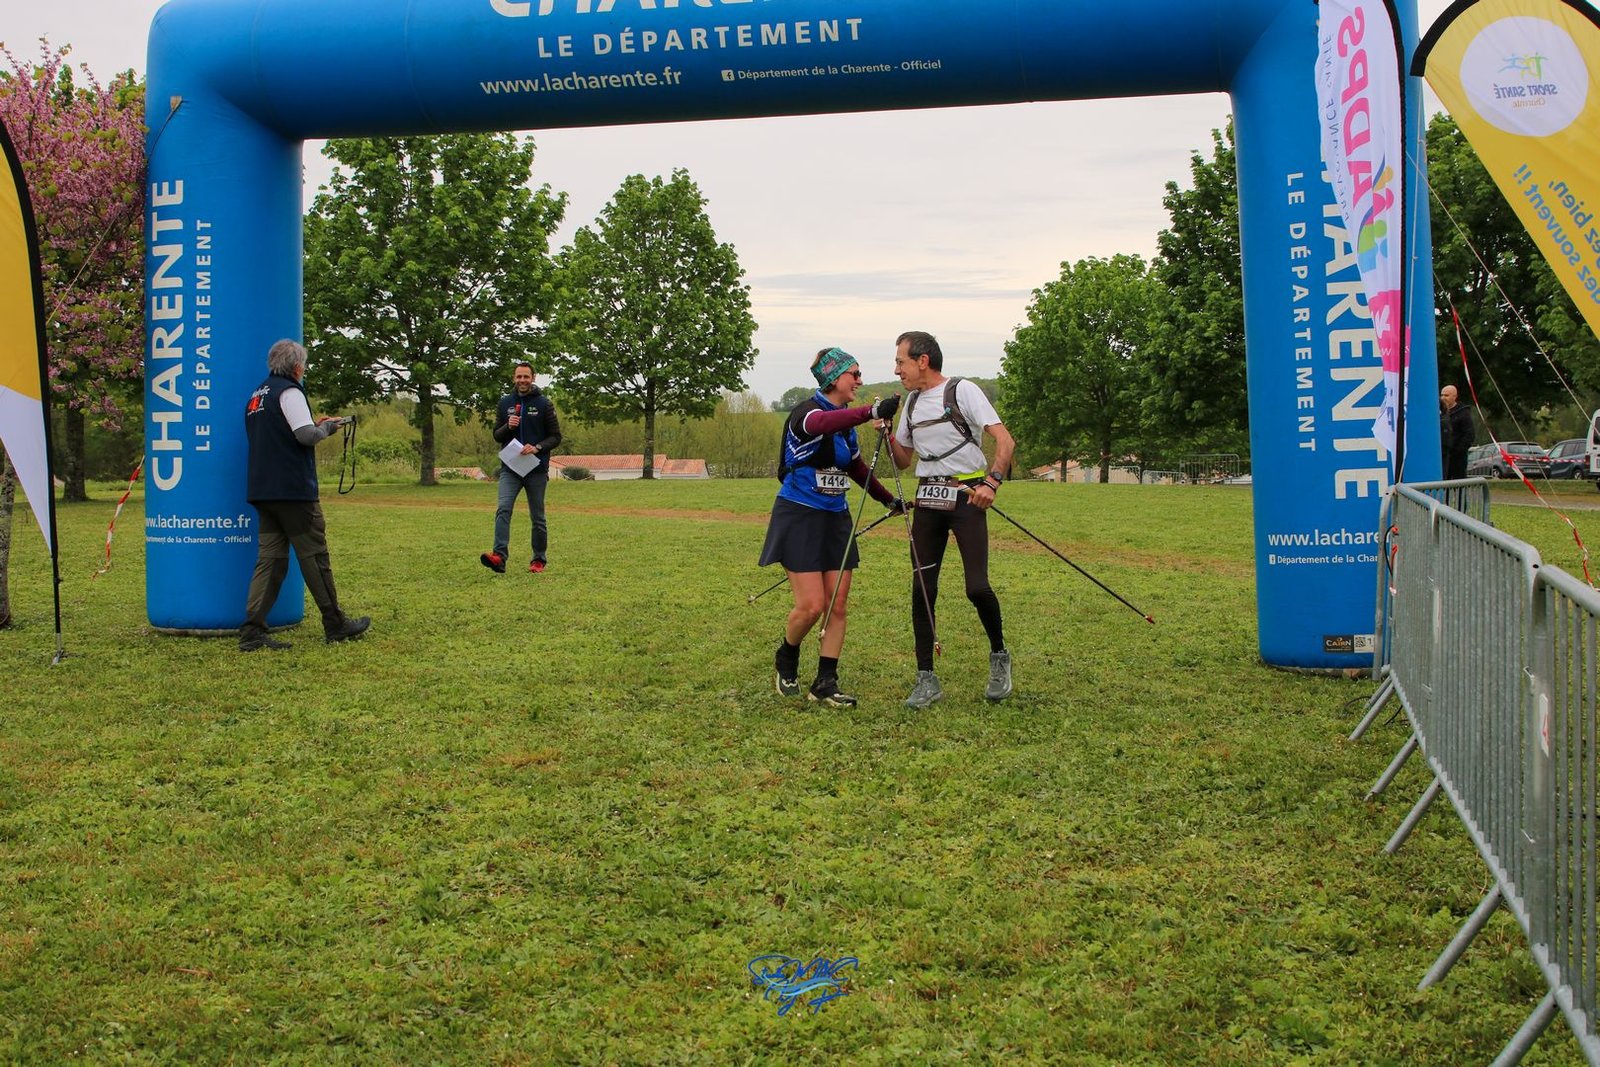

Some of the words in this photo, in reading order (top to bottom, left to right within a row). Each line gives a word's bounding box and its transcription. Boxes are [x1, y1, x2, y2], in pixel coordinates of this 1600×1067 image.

[537, 35, 574, 58] LE
[593, 18, 862, 55] DÉPARTEMENT
[480, 66, 681, 94] www.lacharente.fr
[738, 68, 809, 81] Département
[811, 65, 825, 76] de
[828, 64, 838, 75] la
[841, 62, 891, 74] Charente
[901, 59, 941, 71] Officiel
[1287, 172, 1305, 205] LE
[192, 219, 211, 410] DÉPARTEMENT
[152, 179, 185, 491] CHARENTE
[1289, 222, 1316, 452] DÉPARTEMENT
[196, 425, 211, 451] LE
[821, 475, 845, 488] 1414
[922, 486, 949, 499] 1430
[183, 536, 217, 544] Charente
[223, 535, 252, 543] Officiel
[1277, 555, 1329, 566] Département
[1332, 554, 1344, 563] de
[1346, 554, 1355, 563] la
